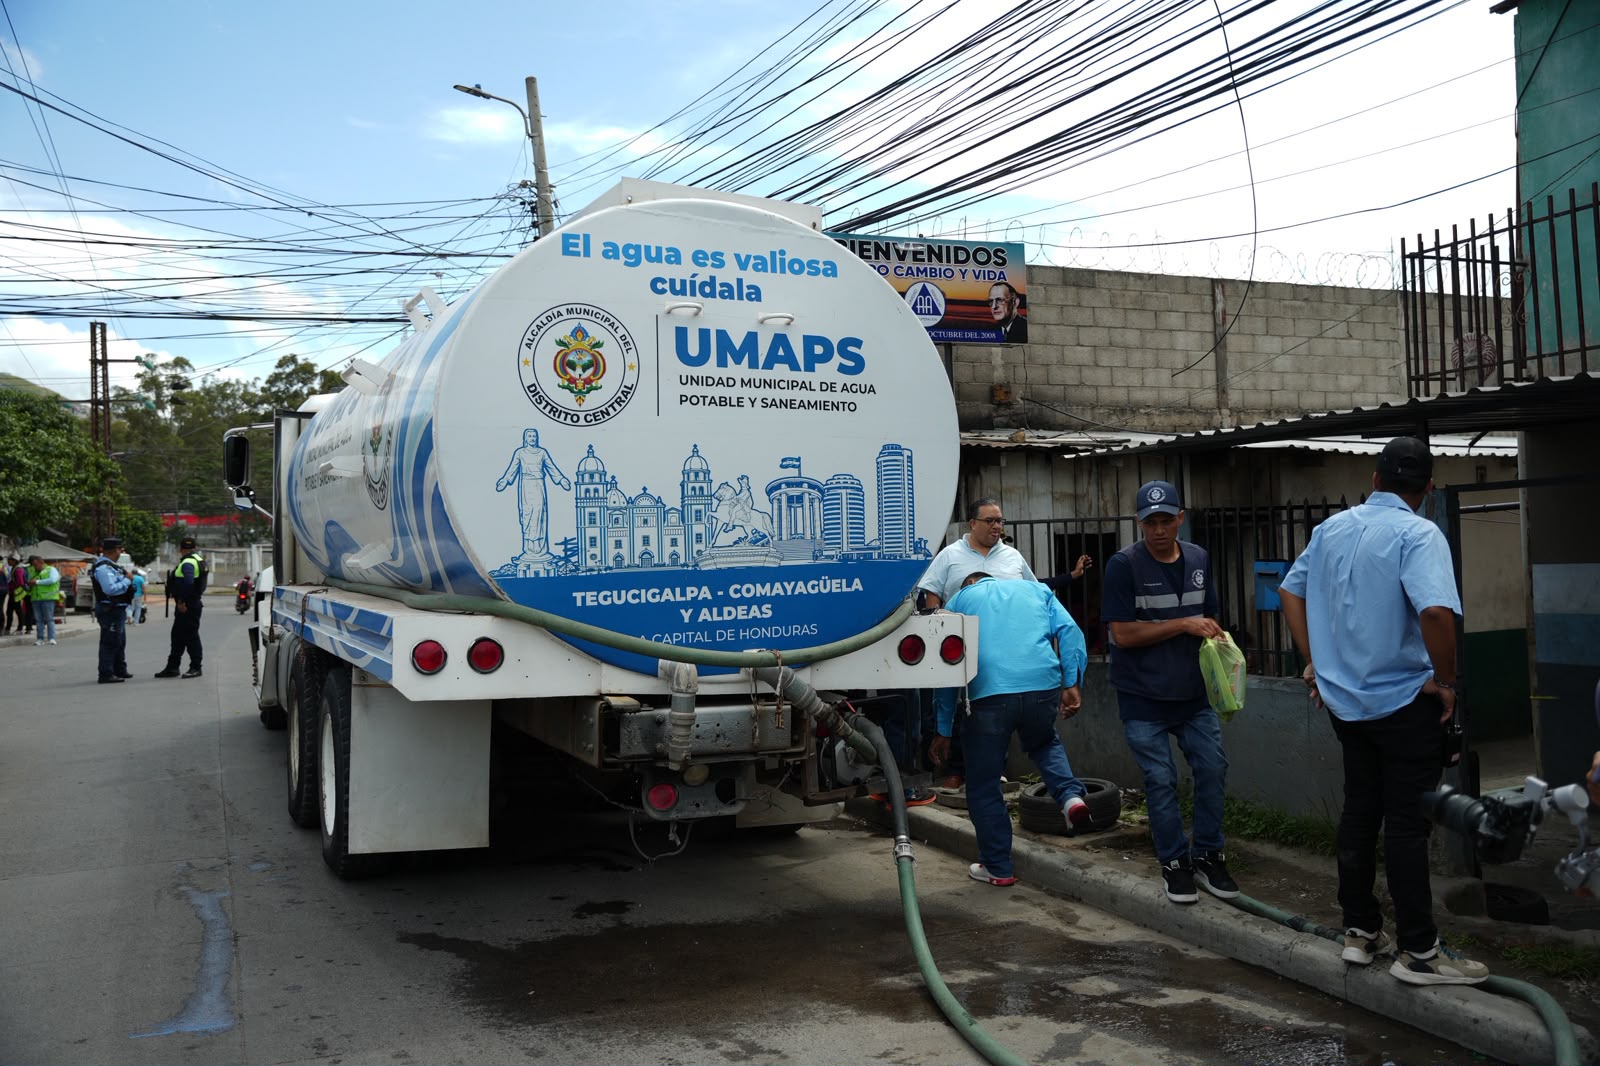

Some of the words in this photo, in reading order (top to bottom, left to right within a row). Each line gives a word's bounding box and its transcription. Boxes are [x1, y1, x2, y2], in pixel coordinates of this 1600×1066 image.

[561, 233, 591, 258] El
[602, 241, 681, 267] agua
[691, 249, 726, 269] es
[734, 249, 838, 278] valiosa
[893, 265, 954, 280] CAMBIO
[959, 268, 970, 280] Y
[972, 269, 1007, 281] VIDA
[649, 273, 762, 302] cuídala
[525, 310, 564, 350] ALCALDÍA
[566, 307, 619, 334] MUNICIPAL
[619, 334, 633, 354] DEL
[964, 331, 979, 339] DEL
[675, 326, 866, 376] UMAPS
[679, 374, 736, 388] UNIDAD
[740, 377, 816, 392] MUNICIPAL
[820, 381, 837, 393] DE
[840, 382, 877, 395] AGUA
[527, 383, 580, 423] DISTRITO
[583, 383, 634, 423] CENTRAL
[679, 394, 744, 408] POTABLE
[748, 397, 758, 408] Y
[761, 397, 857, 412] SANEAMIENTO
[572, 585, 712, 607] TEGUCIGALPA
[728, 576, 863, 599] COMAYAGÜELA
[680, 608, 694, 623] Y
[697, 604, 773, 622] ALDEAS
[652, 631, 712, 644] CAPITAL
[716, 629, 735, 641] DE
[739, 623, 818, 639] HONDURAS
